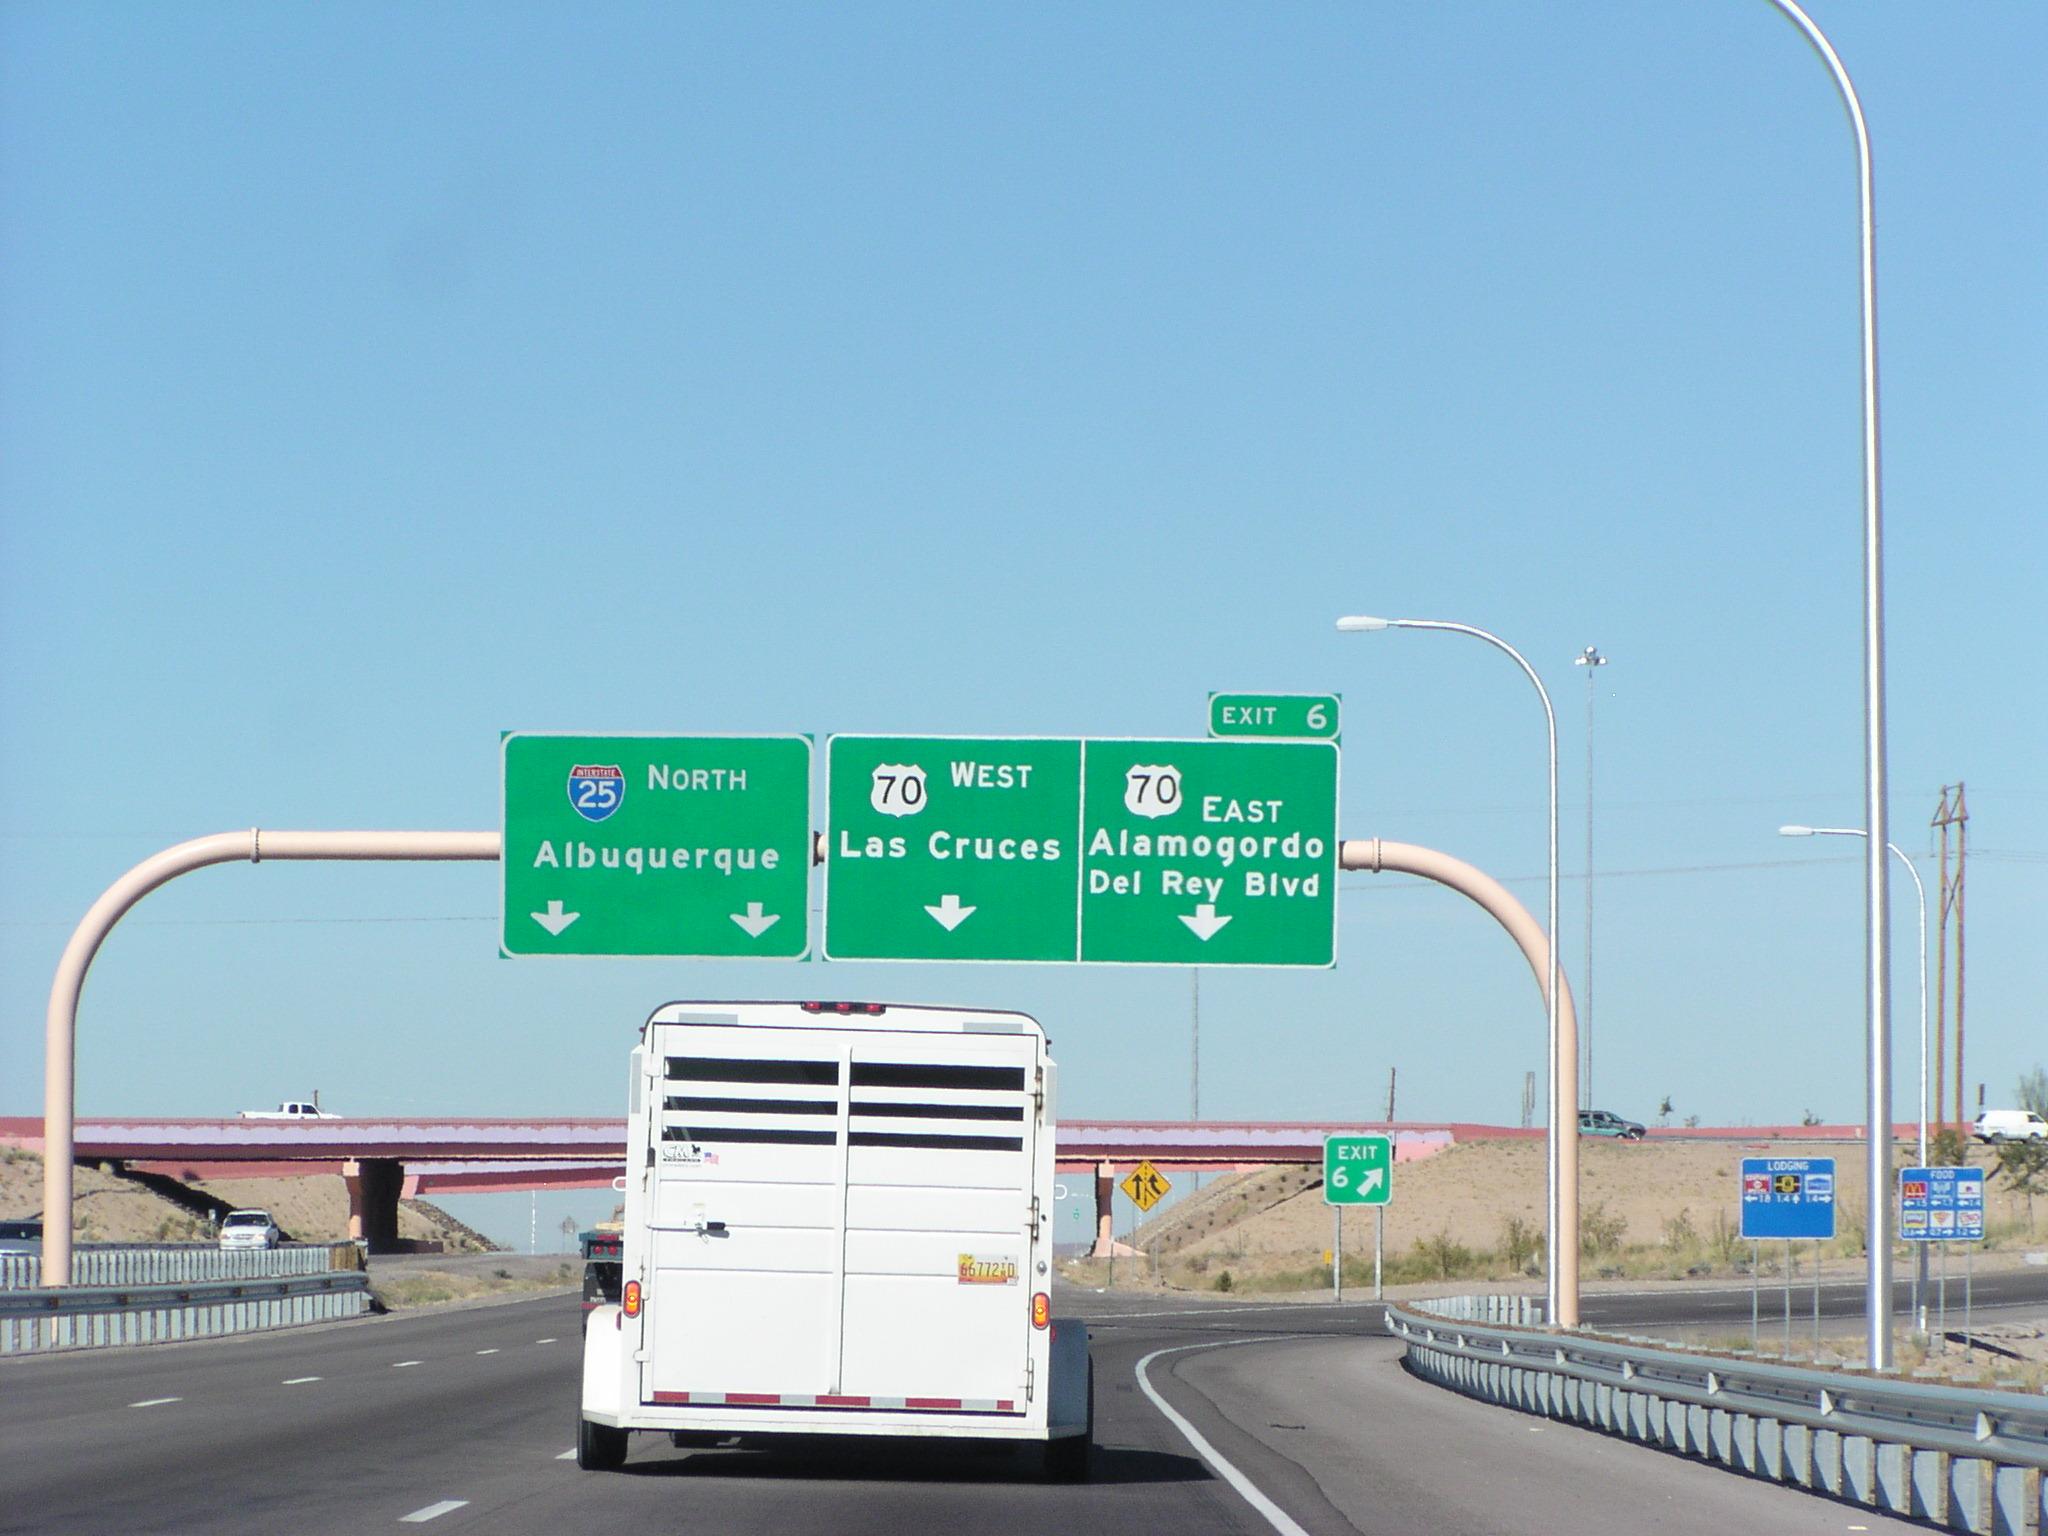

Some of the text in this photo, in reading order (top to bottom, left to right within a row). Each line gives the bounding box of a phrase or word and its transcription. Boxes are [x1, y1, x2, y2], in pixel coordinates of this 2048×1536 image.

[1222, 704, 1328, 730] EXIT 6
[576, 767, 617, 778] INTERSTATE
[647, 764, 747, 791] NORTH
[950, 761, 1033, 789] WEST
[577, 780, 617, 809] 25
[877, 776, 922, 805] 70
[1131, 774, 1177, 804] 70
[1202, 795, 1283, 823] EAST
[533, 839, 780, 876] Albuquerque
[840, 830, 1061, 861] Las Cruces
[1088, 828, 1324, 867] Alamogordo
[1089, 869, 1320, 903] Del Rey Blvd
[1338, 1145, 1378, 1160] EXIT
[1767, 1161, 1809, 1171] LODGING
[1332, 1166, 1349, 1188] 6
[1930, 1170, 1955, 1179] FOOD
